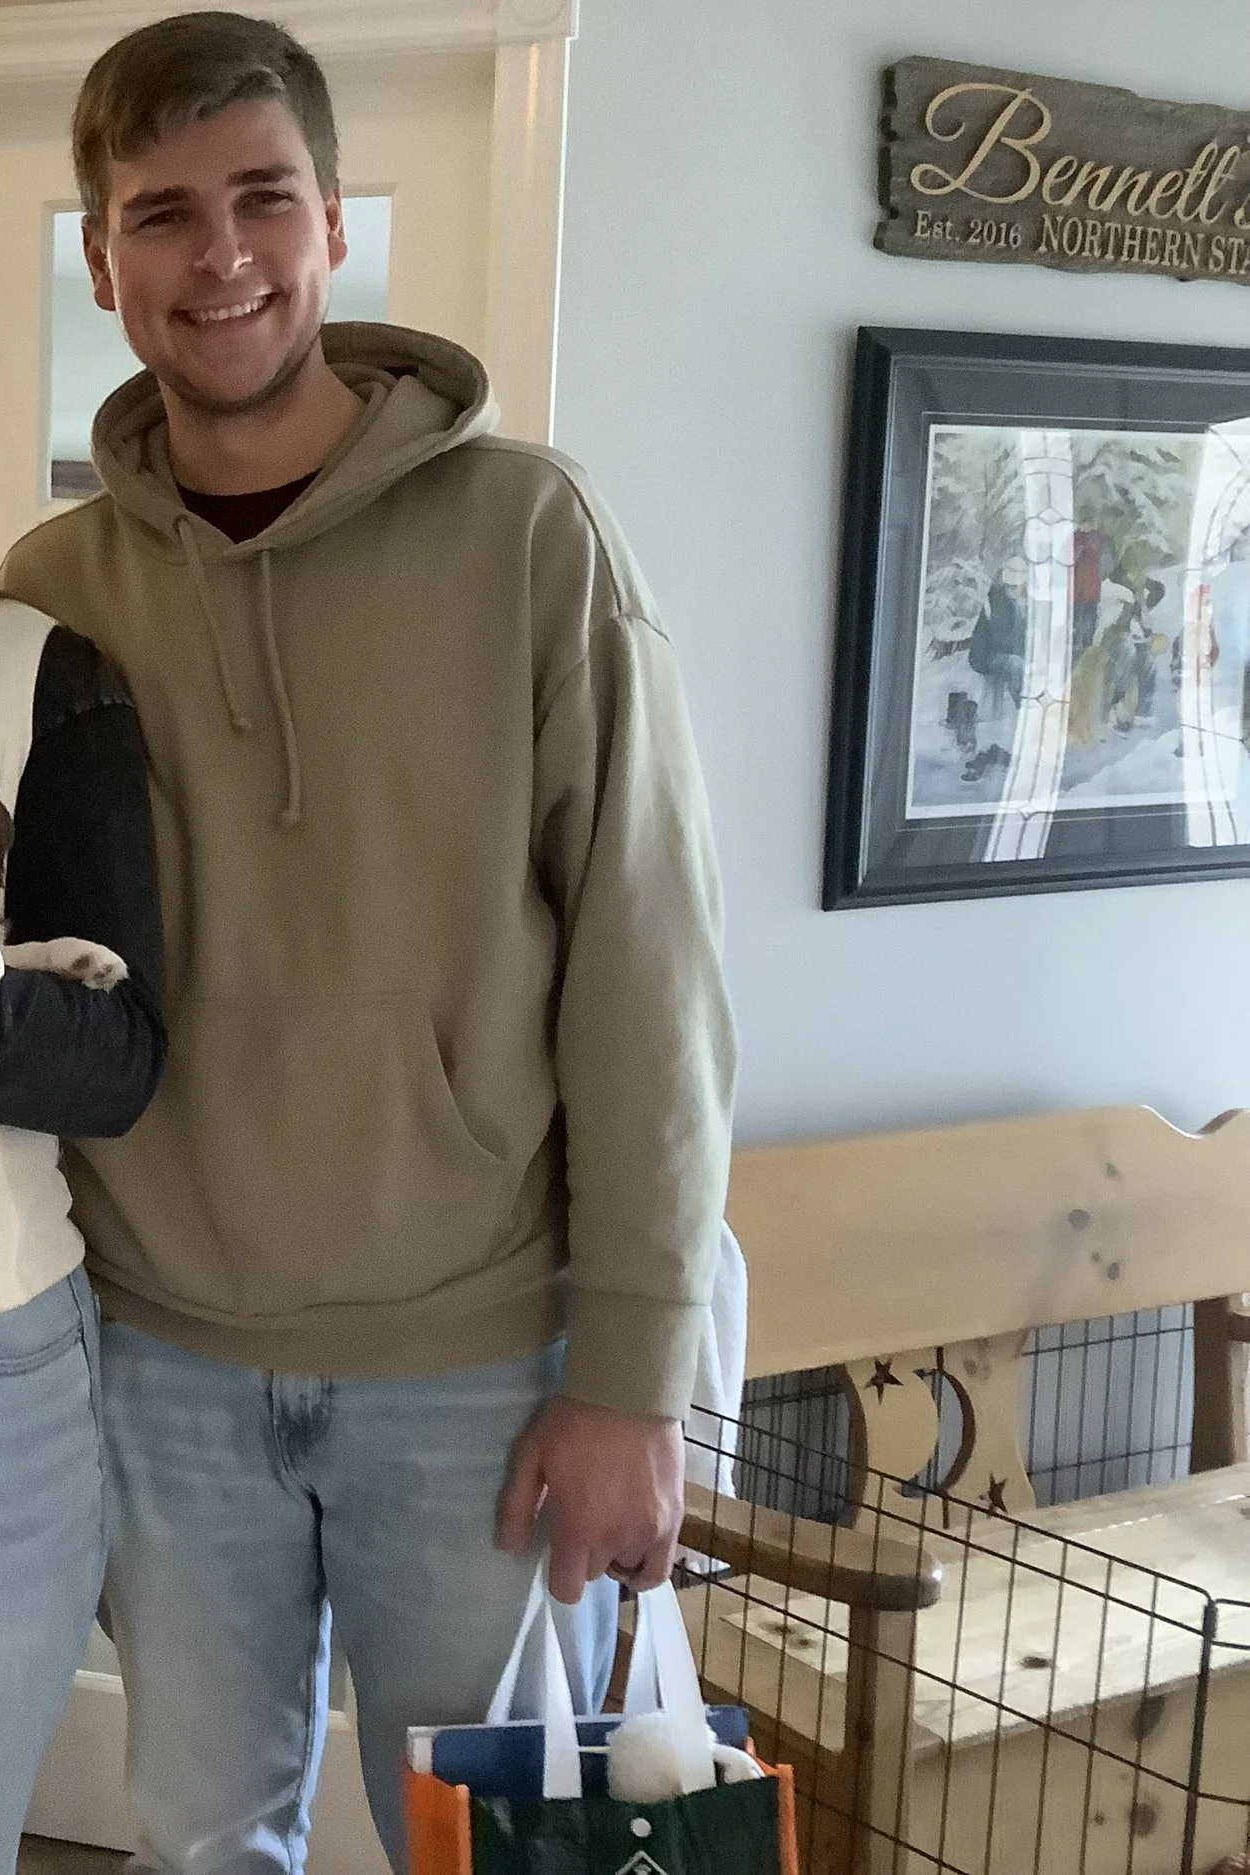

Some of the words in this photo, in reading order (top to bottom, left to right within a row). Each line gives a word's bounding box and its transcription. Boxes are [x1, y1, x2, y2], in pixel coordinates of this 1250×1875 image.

[910, 81, 1241, 224] Bennett
[914, 209, 960, 241] Est.
[967, 219, 1022, 250] 2016
[1037, 213, 1206, 270] NORTHERN
